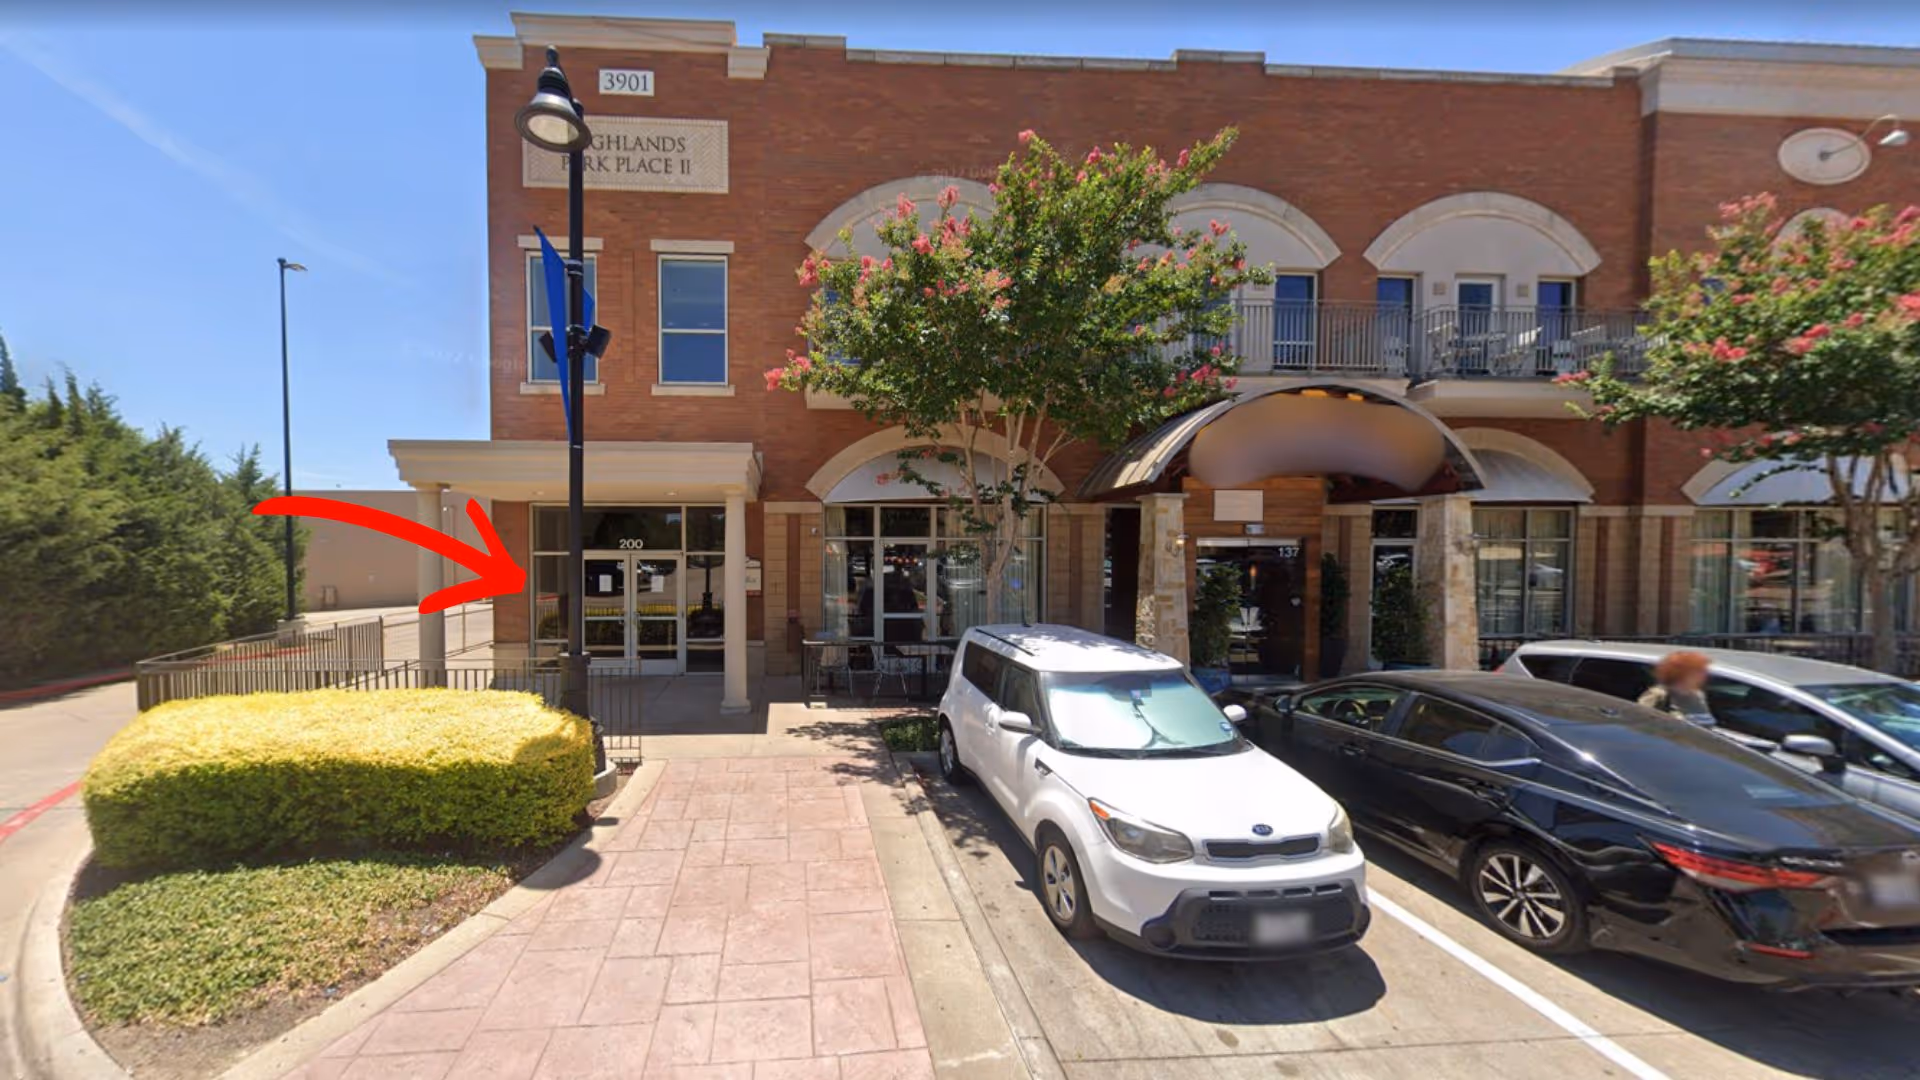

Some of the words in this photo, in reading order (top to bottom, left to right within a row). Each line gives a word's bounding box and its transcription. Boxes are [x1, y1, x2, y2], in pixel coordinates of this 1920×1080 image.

[604, 72, 649, 92] 3901
[590, 134, 687, 154] GHLANDS
[560, 155, 611, 173] PRK
[616, 156, 674, 174] PLACE
[680, 158, 692, 176] II
[619, 538, 644, 549] 200
[1278, 546, 1300, 558] 137
